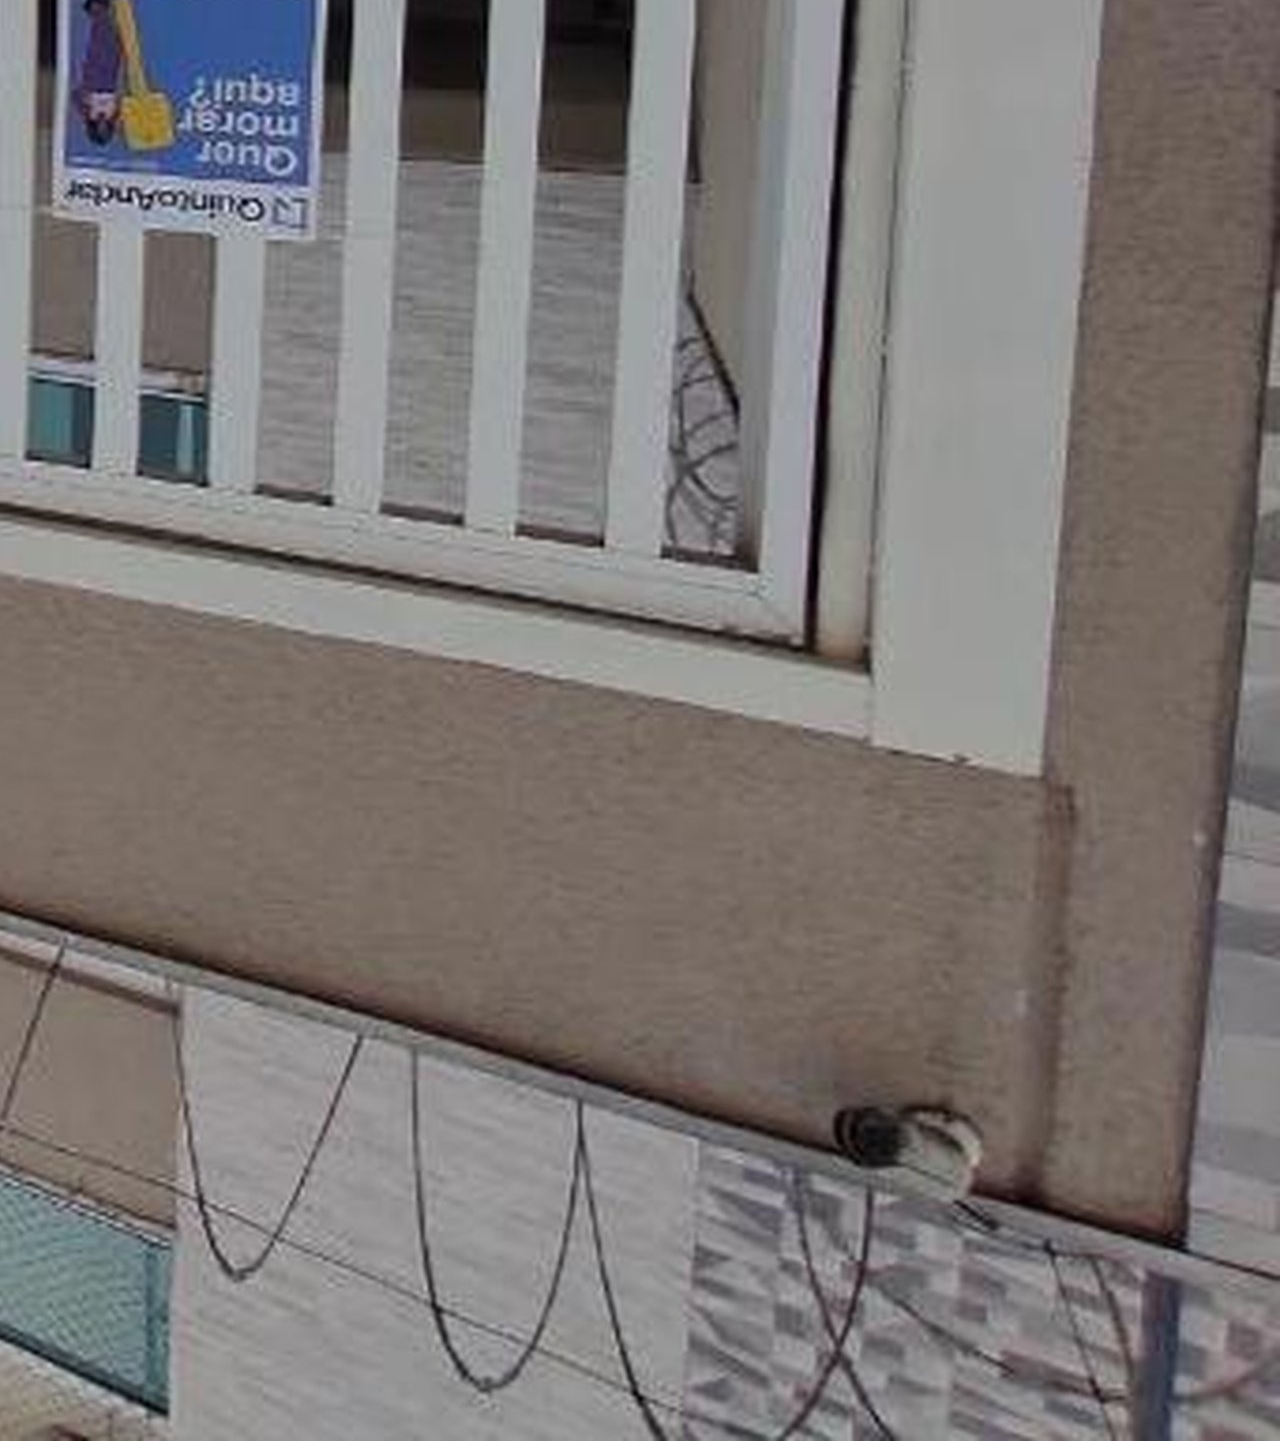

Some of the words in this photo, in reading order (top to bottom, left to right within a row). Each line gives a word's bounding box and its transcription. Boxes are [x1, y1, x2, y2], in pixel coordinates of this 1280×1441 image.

[189, 74, 299, 108] aqui?
[178, 109, 299, 137] morar
[197, 141, 297, 176] Quer
[66, 180, 265, 222] QuintoAndar
